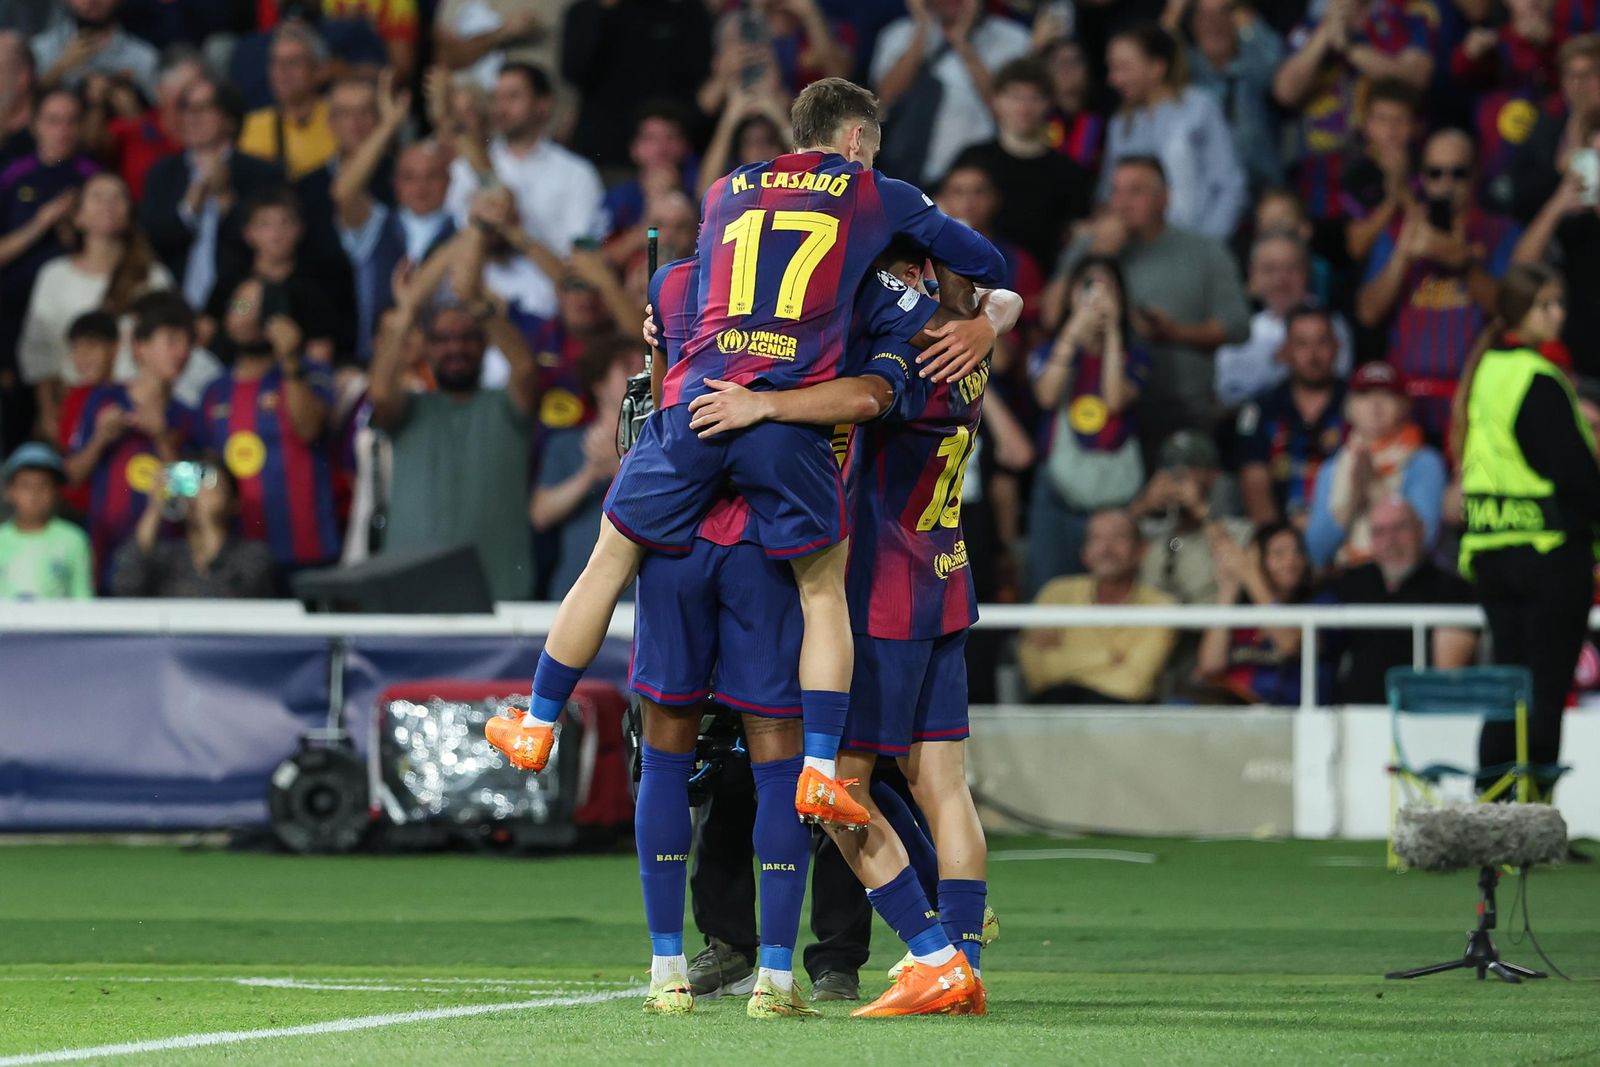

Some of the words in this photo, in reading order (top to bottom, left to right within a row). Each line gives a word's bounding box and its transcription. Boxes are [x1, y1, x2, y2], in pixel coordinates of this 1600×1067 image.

[731, 173, 755, 195] M.
[760, 171, 851, 197] CASADÓ
[721, 209, 841, 321] 17
[747, 341, 796, 357] ACNUR
[751, 331, 797, 349] UNHCR
[872, 352, 908, 371] MBILIGHT
